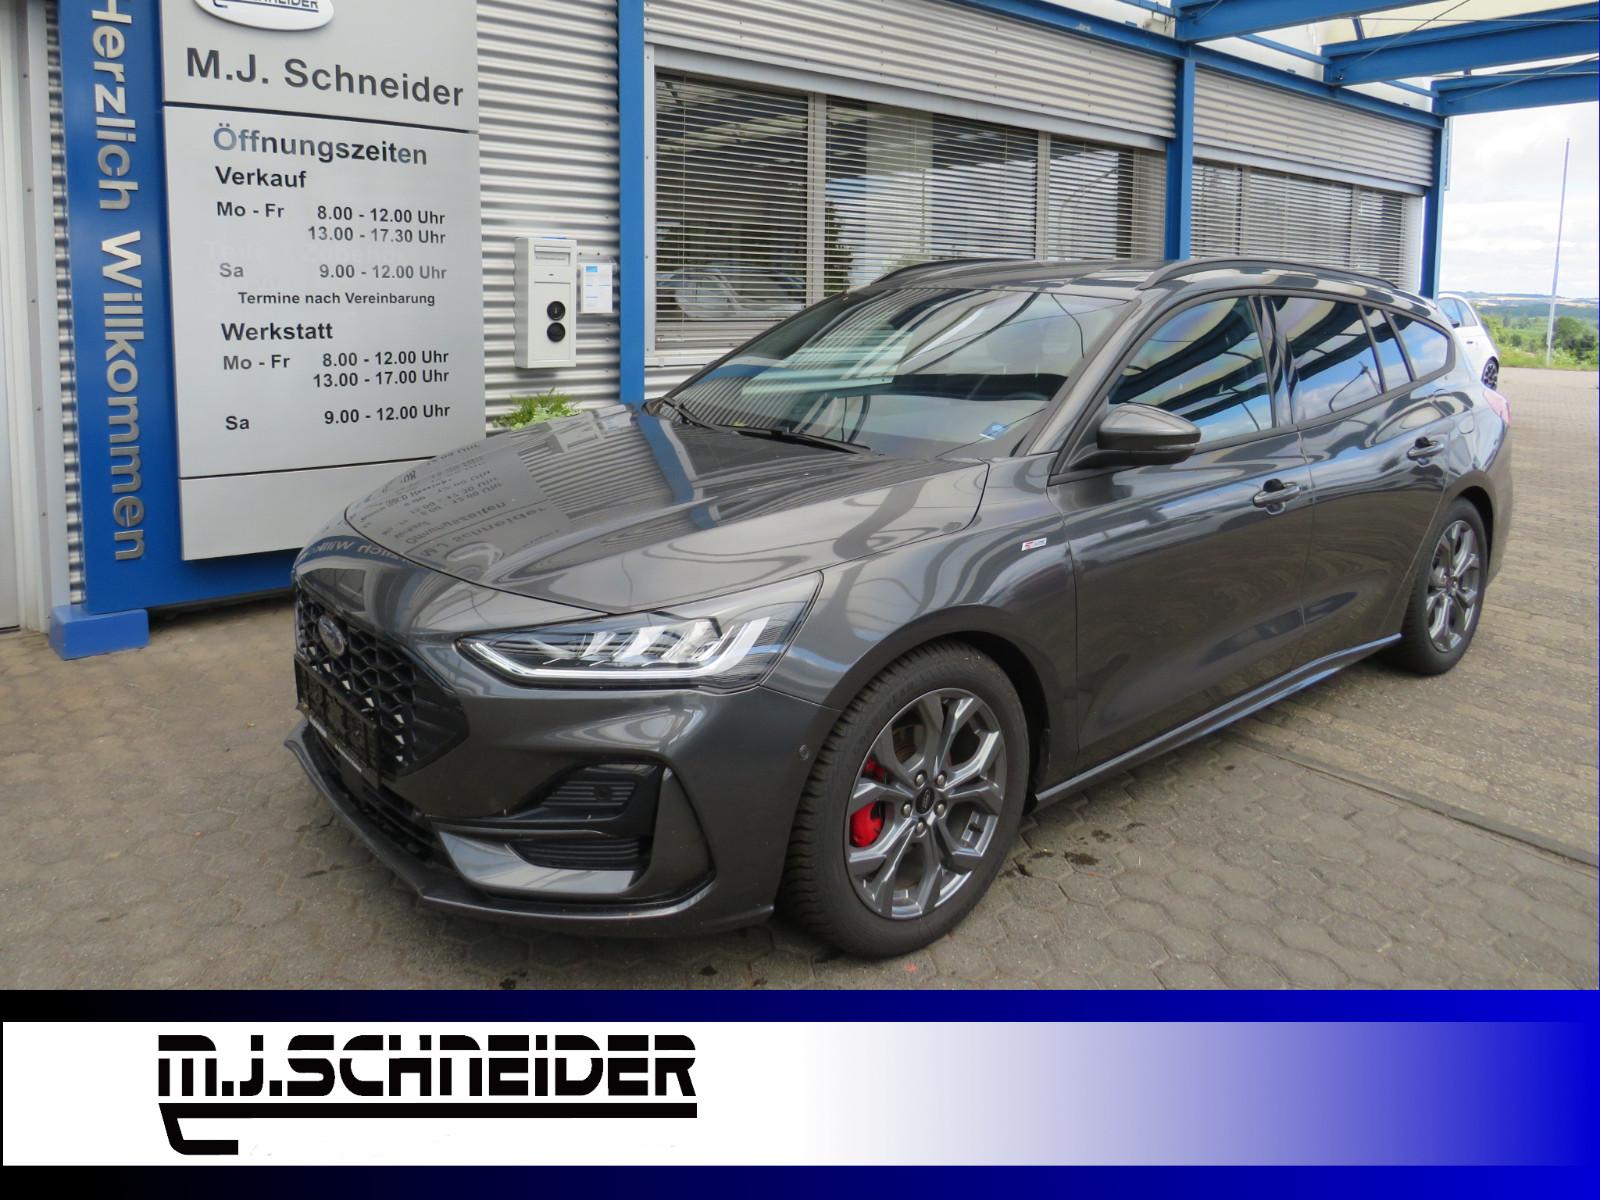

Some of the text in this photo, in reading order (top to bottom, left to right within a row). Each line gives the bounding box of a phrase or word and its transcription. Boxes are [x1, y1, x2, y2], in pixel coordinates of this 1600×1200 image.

[186, 47, 464, 107] M.J. Schneider
[213, 123, 427, 165] Öffnungszeiten
[214, 165, 307, 188] Verkauf
[216, 201, 246, 217] Mo
[265, 203, 285, 218] Fr
[317, 205, 353, 221] 8.00
[370, 207, 413, 224] 12.00
[417, 210, 446, 225] Uhr
[308, 225, 354, 242] 13.00
[371, 228, 413, 243] 17.30
[418, 229, 446, 244] Uhr
[91, 0, 146, 561] Herzlich Willkommen
[219, 262, 244, 278] Sa
[319, 263, 355, 279] 9.00
[372, 264, 414, 279] 12.00
[419, 265, 448, 280] Uhr
[237, 291, 435, 307] Termine nach Vereinbarung
[220, 322, 333, 341] Werkstatt
[223, 355, 252, 371] Mo
[271, 354, 291, 369] Fr
[322, 352, 358, 368] 8.00
[375, 350, 417, 365] 12.00
[421, 350, 449, 364] Uhr
[313, 372, 359, 388] 13.00
[375, 369, 417, 385] 17.00
[422, 368, 450, 383] Uhr
[225, 415, 250, 431] Sa
[324, 408, 360, 425] 9.00
[376, 405, 418, 421] 12.00
[423, 404, 451, 418] Uhr
